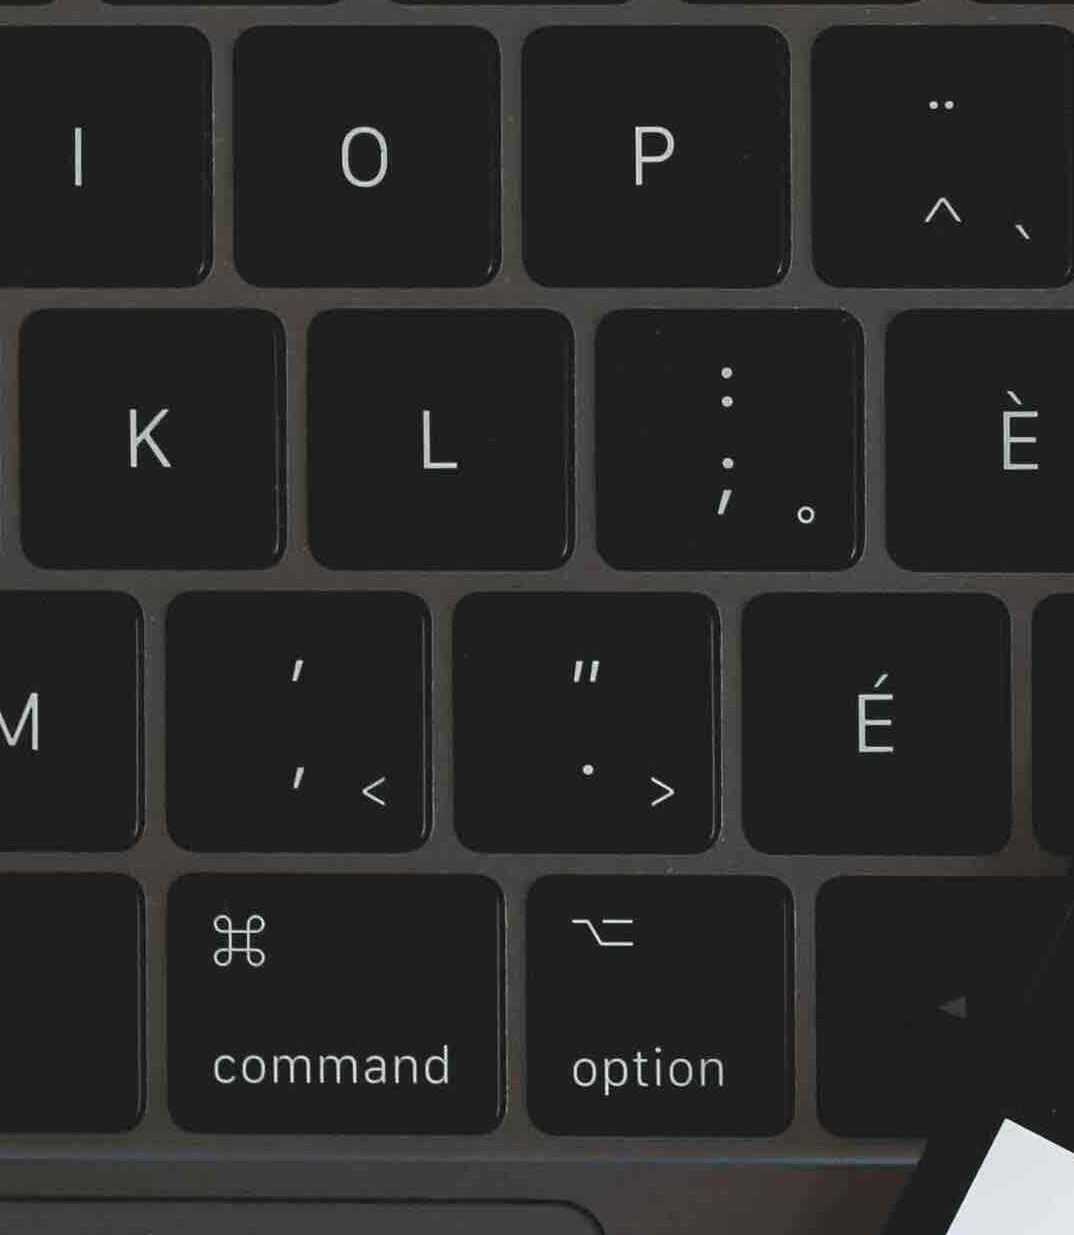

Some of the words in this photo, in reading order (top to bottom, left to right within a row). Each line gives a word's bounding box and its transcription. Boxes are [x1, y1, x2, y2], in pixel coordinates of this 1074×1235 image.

[341, 126, 388, 187] O
[634, 126, 675, 186] P
[129, 408, 172, 468] K
[422, 410, 458, 469] L
[1003, 390, 1039, 471] È
[0, 692, 39, 751] M
[857, 674, 894, 753] É
[213, 1044, 449, 1085] command
[572, 1046, 724, 1097] option
